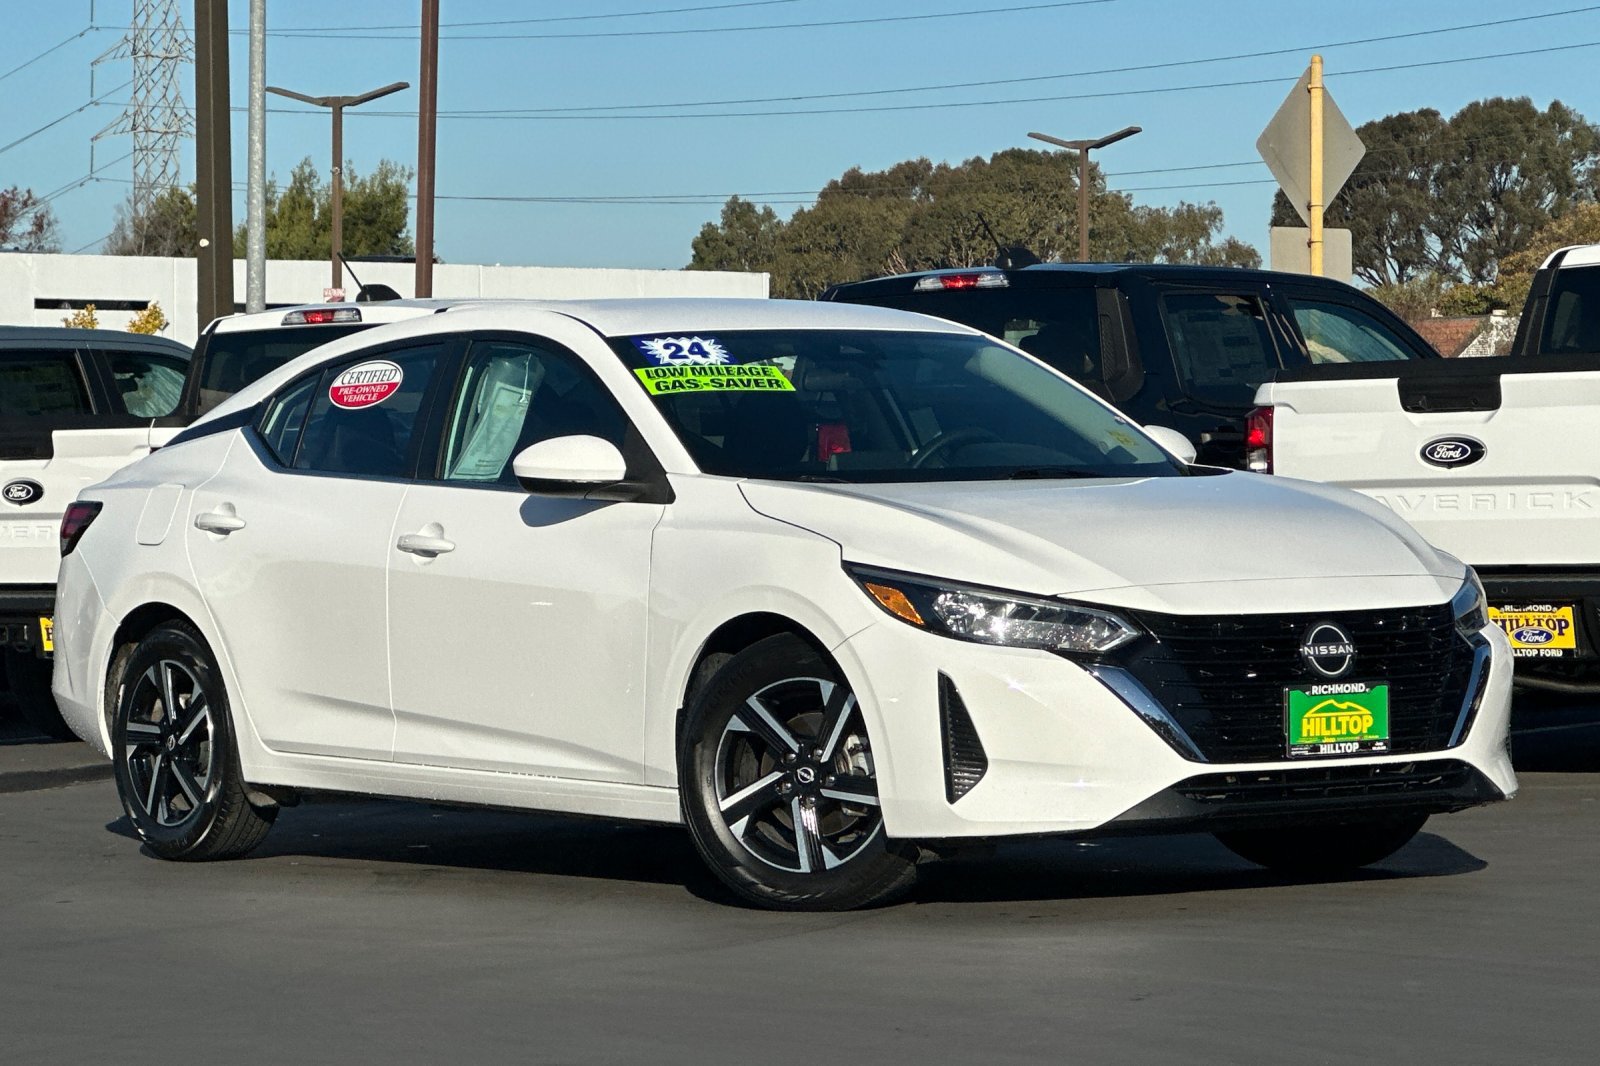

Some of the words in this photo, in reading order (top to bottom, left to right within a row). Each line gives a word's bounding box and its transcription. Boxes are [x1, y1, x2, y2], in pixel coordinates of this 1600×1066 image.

[662, 341, 711, 360] 24
[341, 368, 398, 385] CERTIFIED
[644, 366, 687, 380] LOW
[690, 366, 776, 379] MILEAGE
[338, 384, 389, 396] PRE-OWNED
[343, 392, 379, 403] VEHICLE
[1433, 444, 1463, 459] Ford
[8, 486, 27, 498] Ford
[1520, 630, 1547, 643] Ford
[1303, 644, 1354, 656] NISSAN
[1539, 648, 1563, 657] FORD
[1311, 682, 1366, 695] RICHMOND
[1302, 714, 1374, 737] HILLTOP
[1319, 742, 1360, 754] HILLTOP
